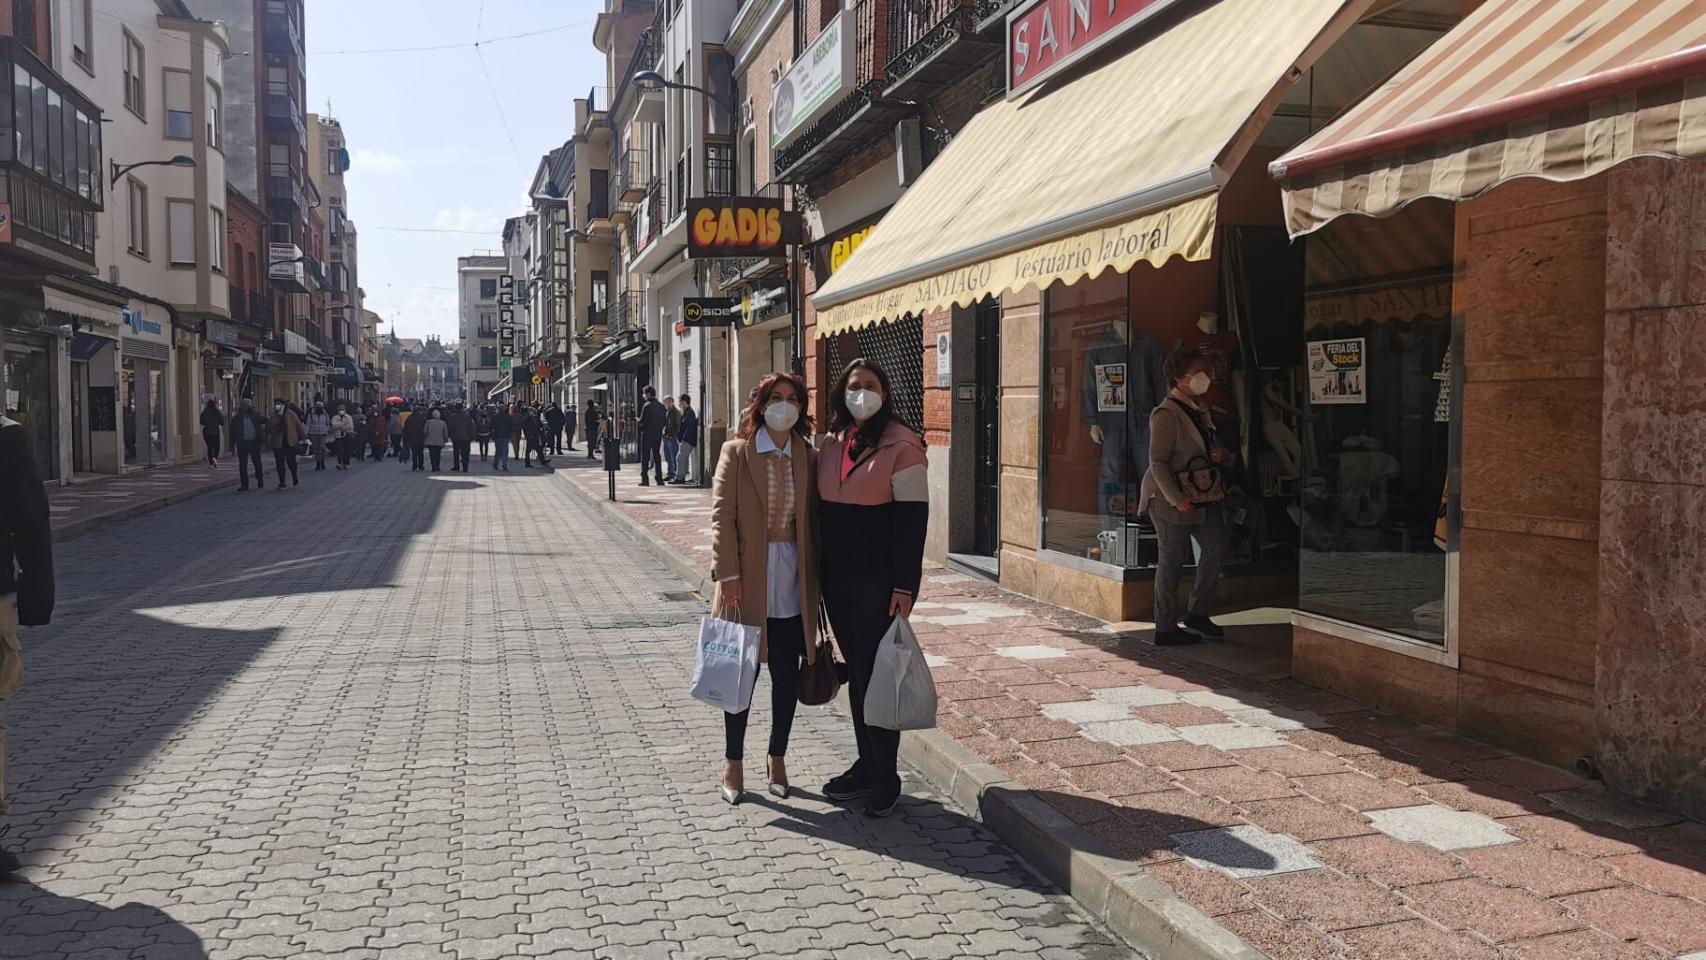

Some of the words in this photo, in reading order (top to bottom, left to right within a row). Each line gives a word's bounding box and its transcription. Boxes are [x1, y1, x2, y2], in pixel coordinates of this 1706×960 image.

[693, 207, 782, 247] GADIS
[876, 292, 904, 312] Hogar
[915, 261, 992, 303] SANTIAGO
[1015, 244, 1091, 280] Vestuario
[1098, 213, 1171, 262] laboral
[501, 276, 513, 356] PEREZ
[1327, 343, 1345, 355] FERIA
[1346, 342, 1359, 353] DEL
[1332, 352, 1359, 364] Stock
[704, 641, 740, 656] COTTON
